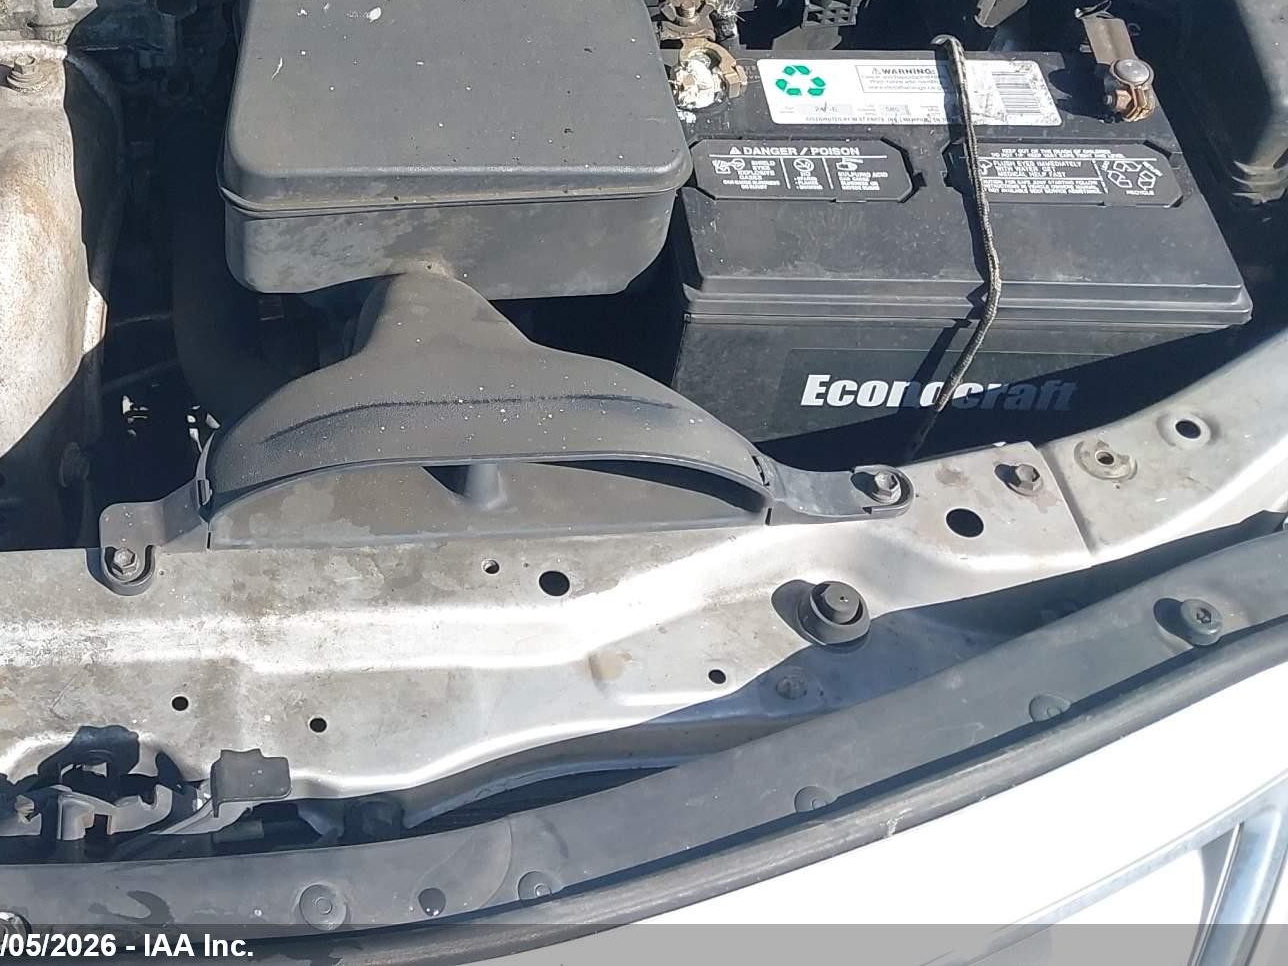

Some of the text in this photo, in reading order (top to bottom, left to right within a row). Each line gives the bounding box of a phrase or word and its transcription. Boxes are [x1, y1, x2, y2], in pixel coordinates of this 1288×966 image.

[743, 146, 798, 155] DANGER
[810, 146, 860, 155] POISON
[800, 374, 1078, 411] Econocraft
